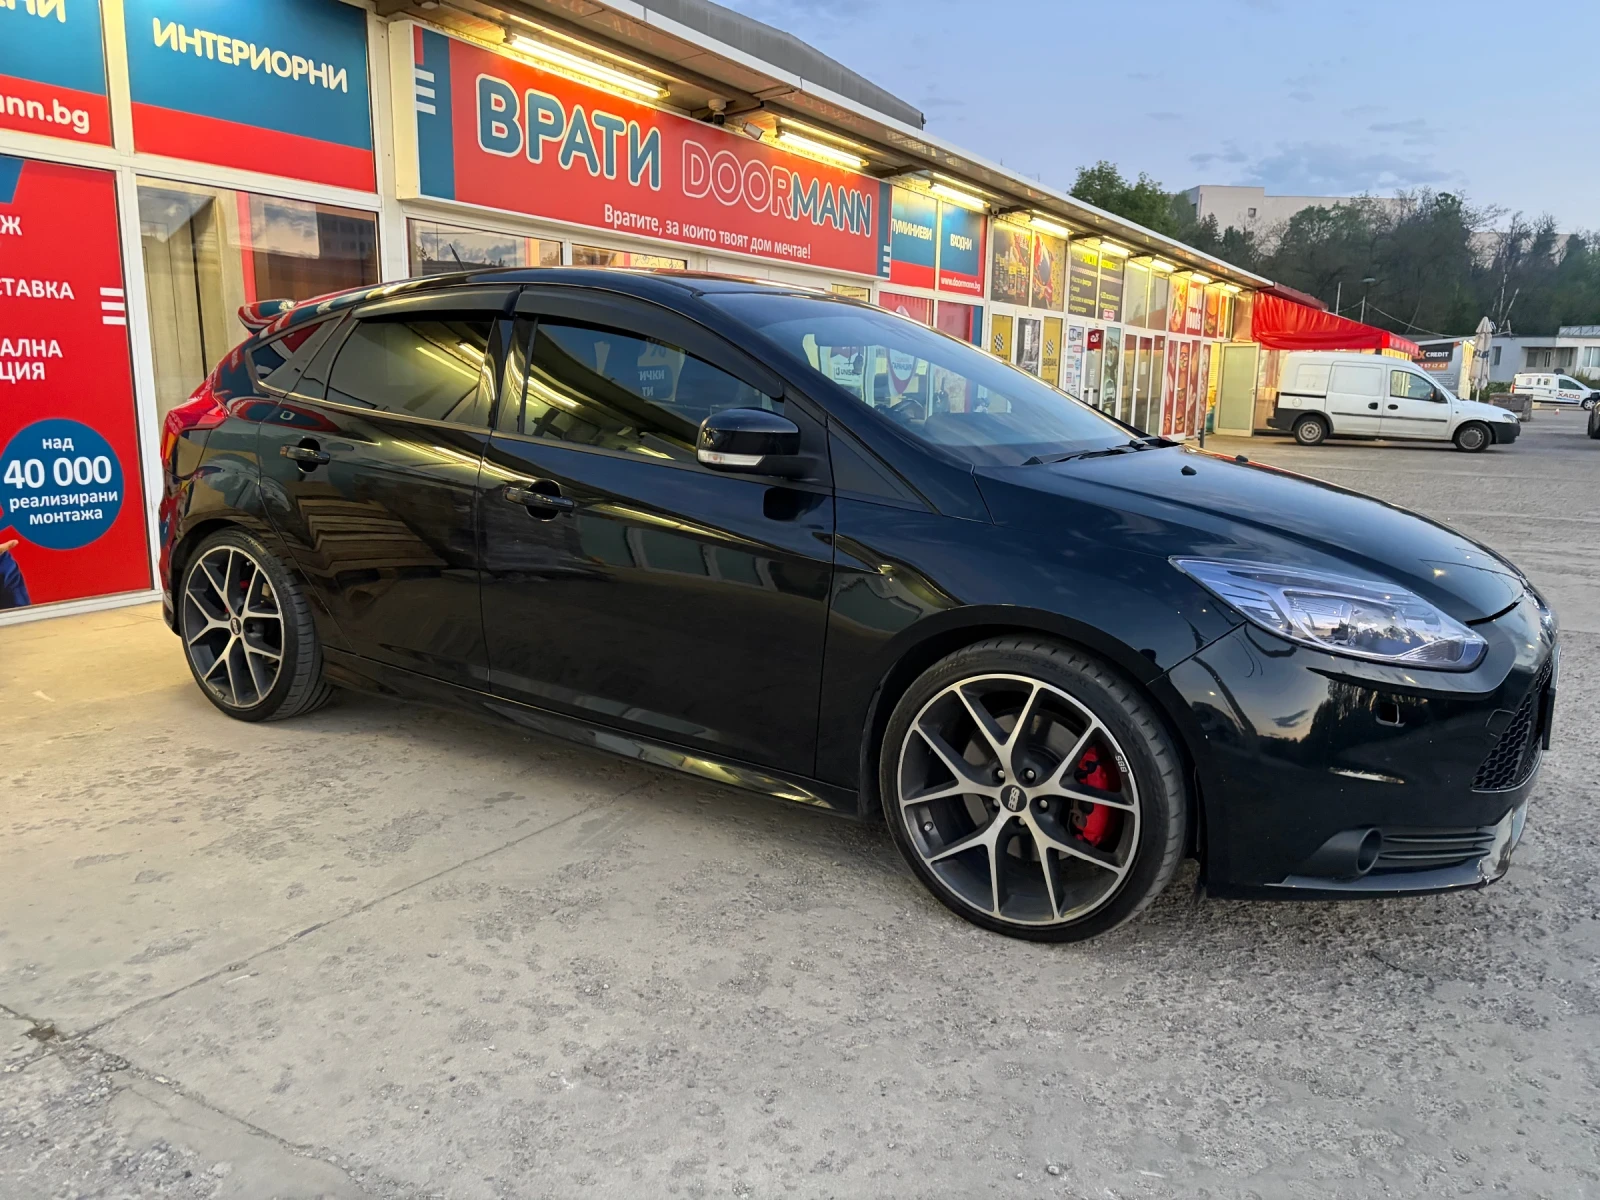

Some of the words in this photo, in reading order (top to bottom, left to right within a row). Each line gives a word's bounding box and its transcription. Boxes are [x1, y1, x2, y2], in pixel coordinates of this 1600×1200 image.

[152, 18, 348, 93] ИНТЕРИОРНИ
[476, 73, 661, 192] ВРАТИ
[682, 139, 872, 237] DOORMANN
[604, 203, 663, 236] Вратите,
[665, 219, 679, 236] за
[682, 222, 717, 242] които
[718, 230, 749, 248] твоят
[750, 237, 772, 253] дом
[774, 243, 811, 259] мечтае!
[0, 277, 76, 300] ТАВКА
[1557, 392, 1581, 400] XADO
[42, 437, 75, 452] над
[3, 458, 45, 489] 40
[53, 455, 112, 487] 000
[9, 490, 118, 513] реализирани
[29, 508, 103, 525] монтажа
[1007, 786, 1021, 812] BBS
